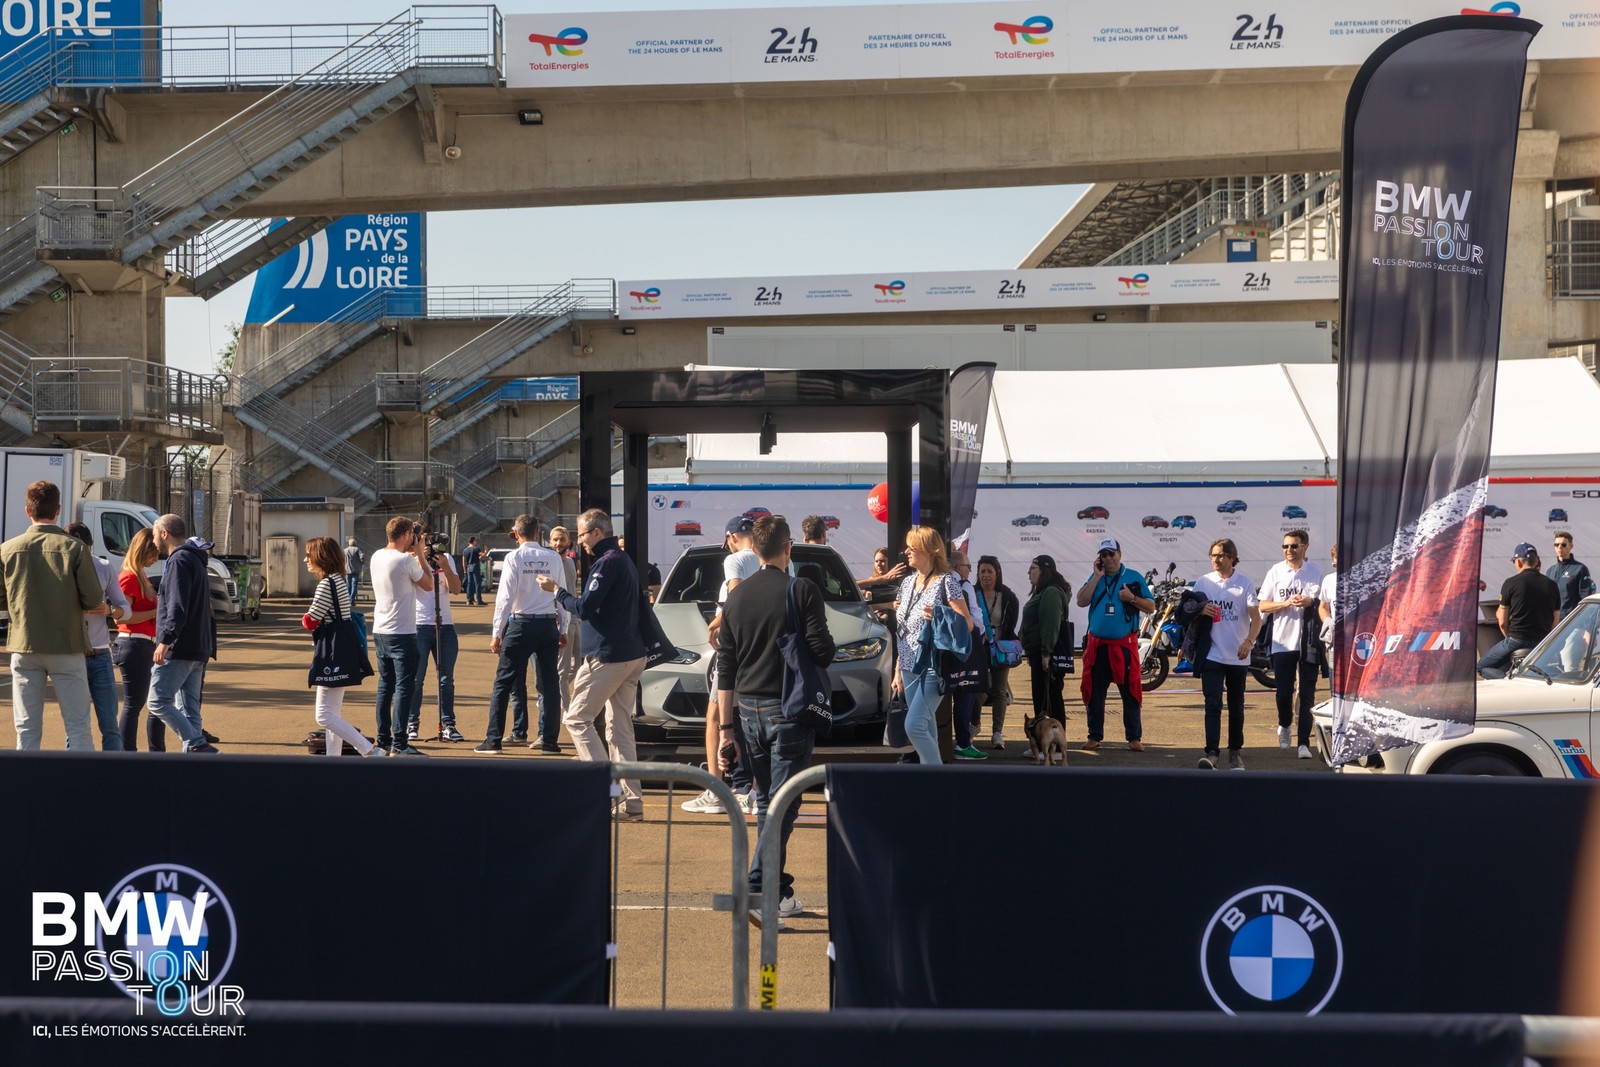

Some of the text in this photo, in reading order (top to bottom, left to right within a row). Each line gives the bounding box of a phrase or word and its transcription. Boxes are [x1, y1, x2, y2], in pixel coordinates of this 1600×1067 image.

[0, 0, 112, 36] OIRE
[1231, 13, 1284, 41] 24h
[766, 26, 818, 55] 24h
[1229, 41, 1281, 50] LE MANS
[764, 54, 815, 63] LE MANS
[994, 50, 1055, 59] TotalEnergies
[529, 62, 589, 71] TotalEnergies
[1375, 180, 1472, 220] BMW
[367, 214, 408, 227] Région
[1374, 213, 1469, 241] PASSION
[345, 228, 408, 251] PAYS
[381, 253, 408, 264] de la
[1420, 239, 1484, 264] TOUR
[336, 266, 409, 289] LOIRE
[1243, 272, 1270, 287] 24h
[755, 286, 783, 301] 24h
[998, 279, 1026, 294] 24h
[950, 419, 977, 435] BMW
[1557, 745, 1586, 754] turbo
[1221, 893, 1325, 932] BMW
